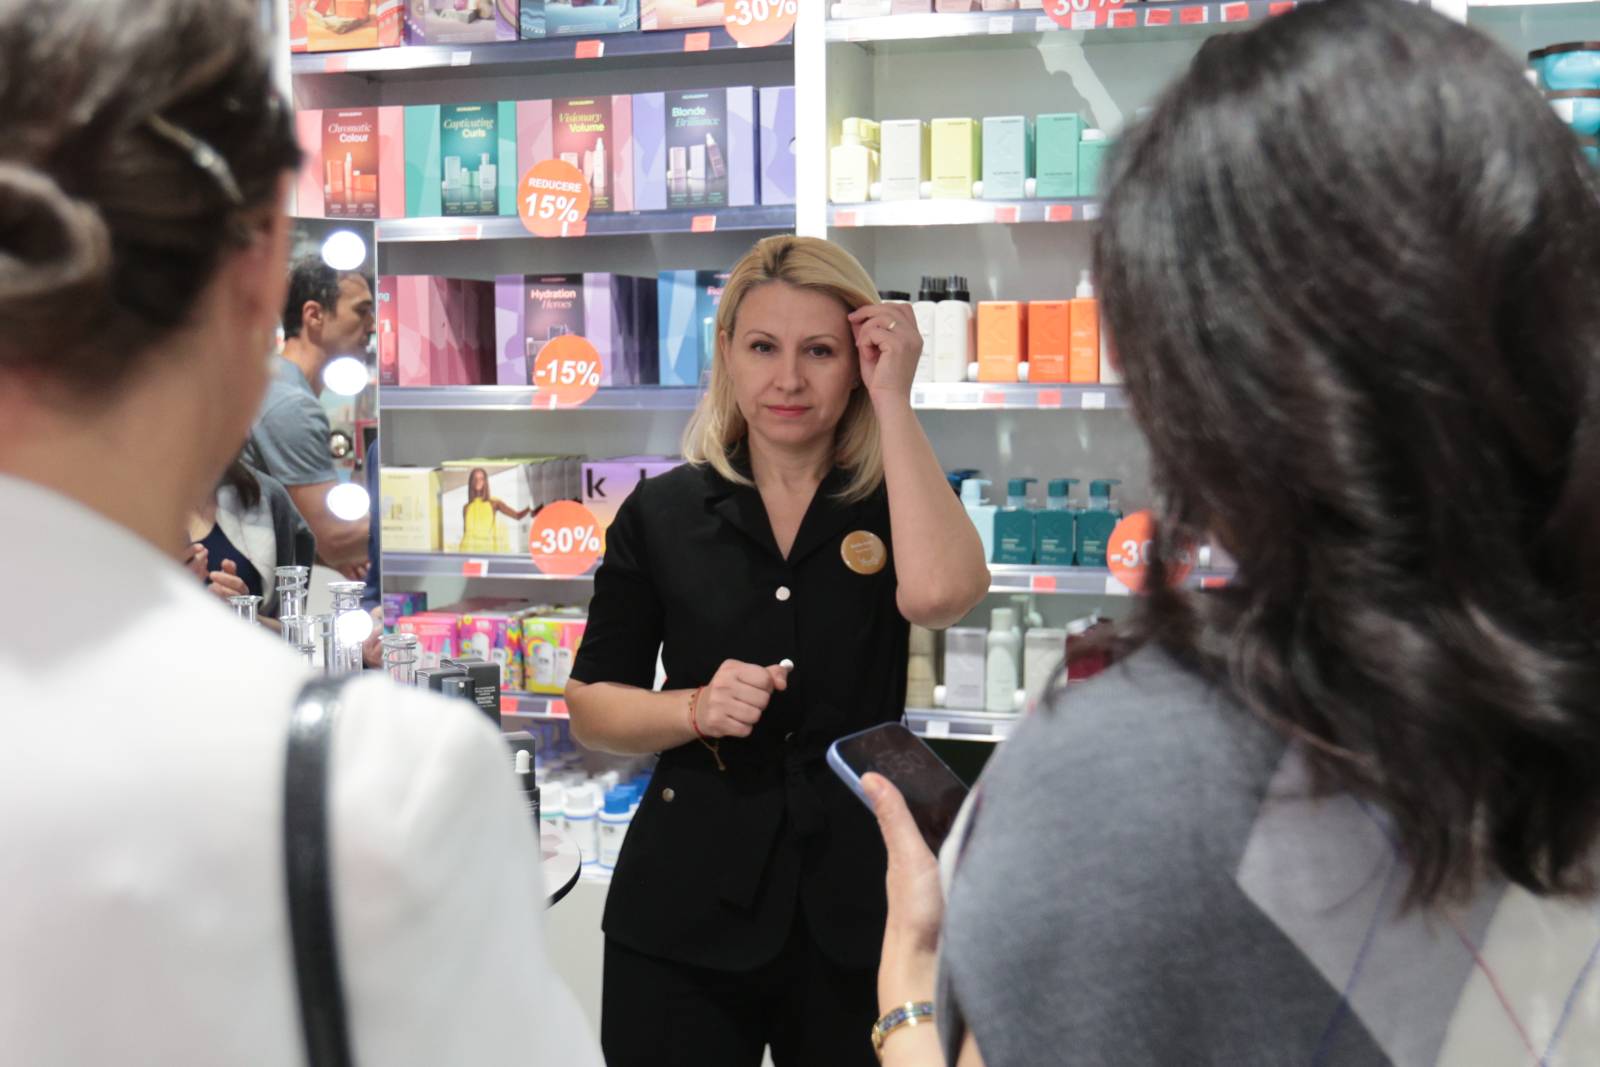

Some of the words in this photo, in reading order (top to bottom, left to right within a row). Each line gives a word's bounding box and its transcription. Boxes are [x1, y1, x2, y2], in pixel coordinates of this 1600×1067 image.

[726, 0, 797, 25] -30%
[671, 106, 706, 117] Blonde
[462, 128, 486, 138] Curls
[569, 123, 605, 133] Volume
[339, 133, 368, 143] Colour
[528, 177, 582, 193] REDUCERE
[525, 192, 579, 222] 15%
[530, 288, 577, 301] Hydration
[536, 359, 600, 386] -15%
[531, 525, 601, 554] -30%
